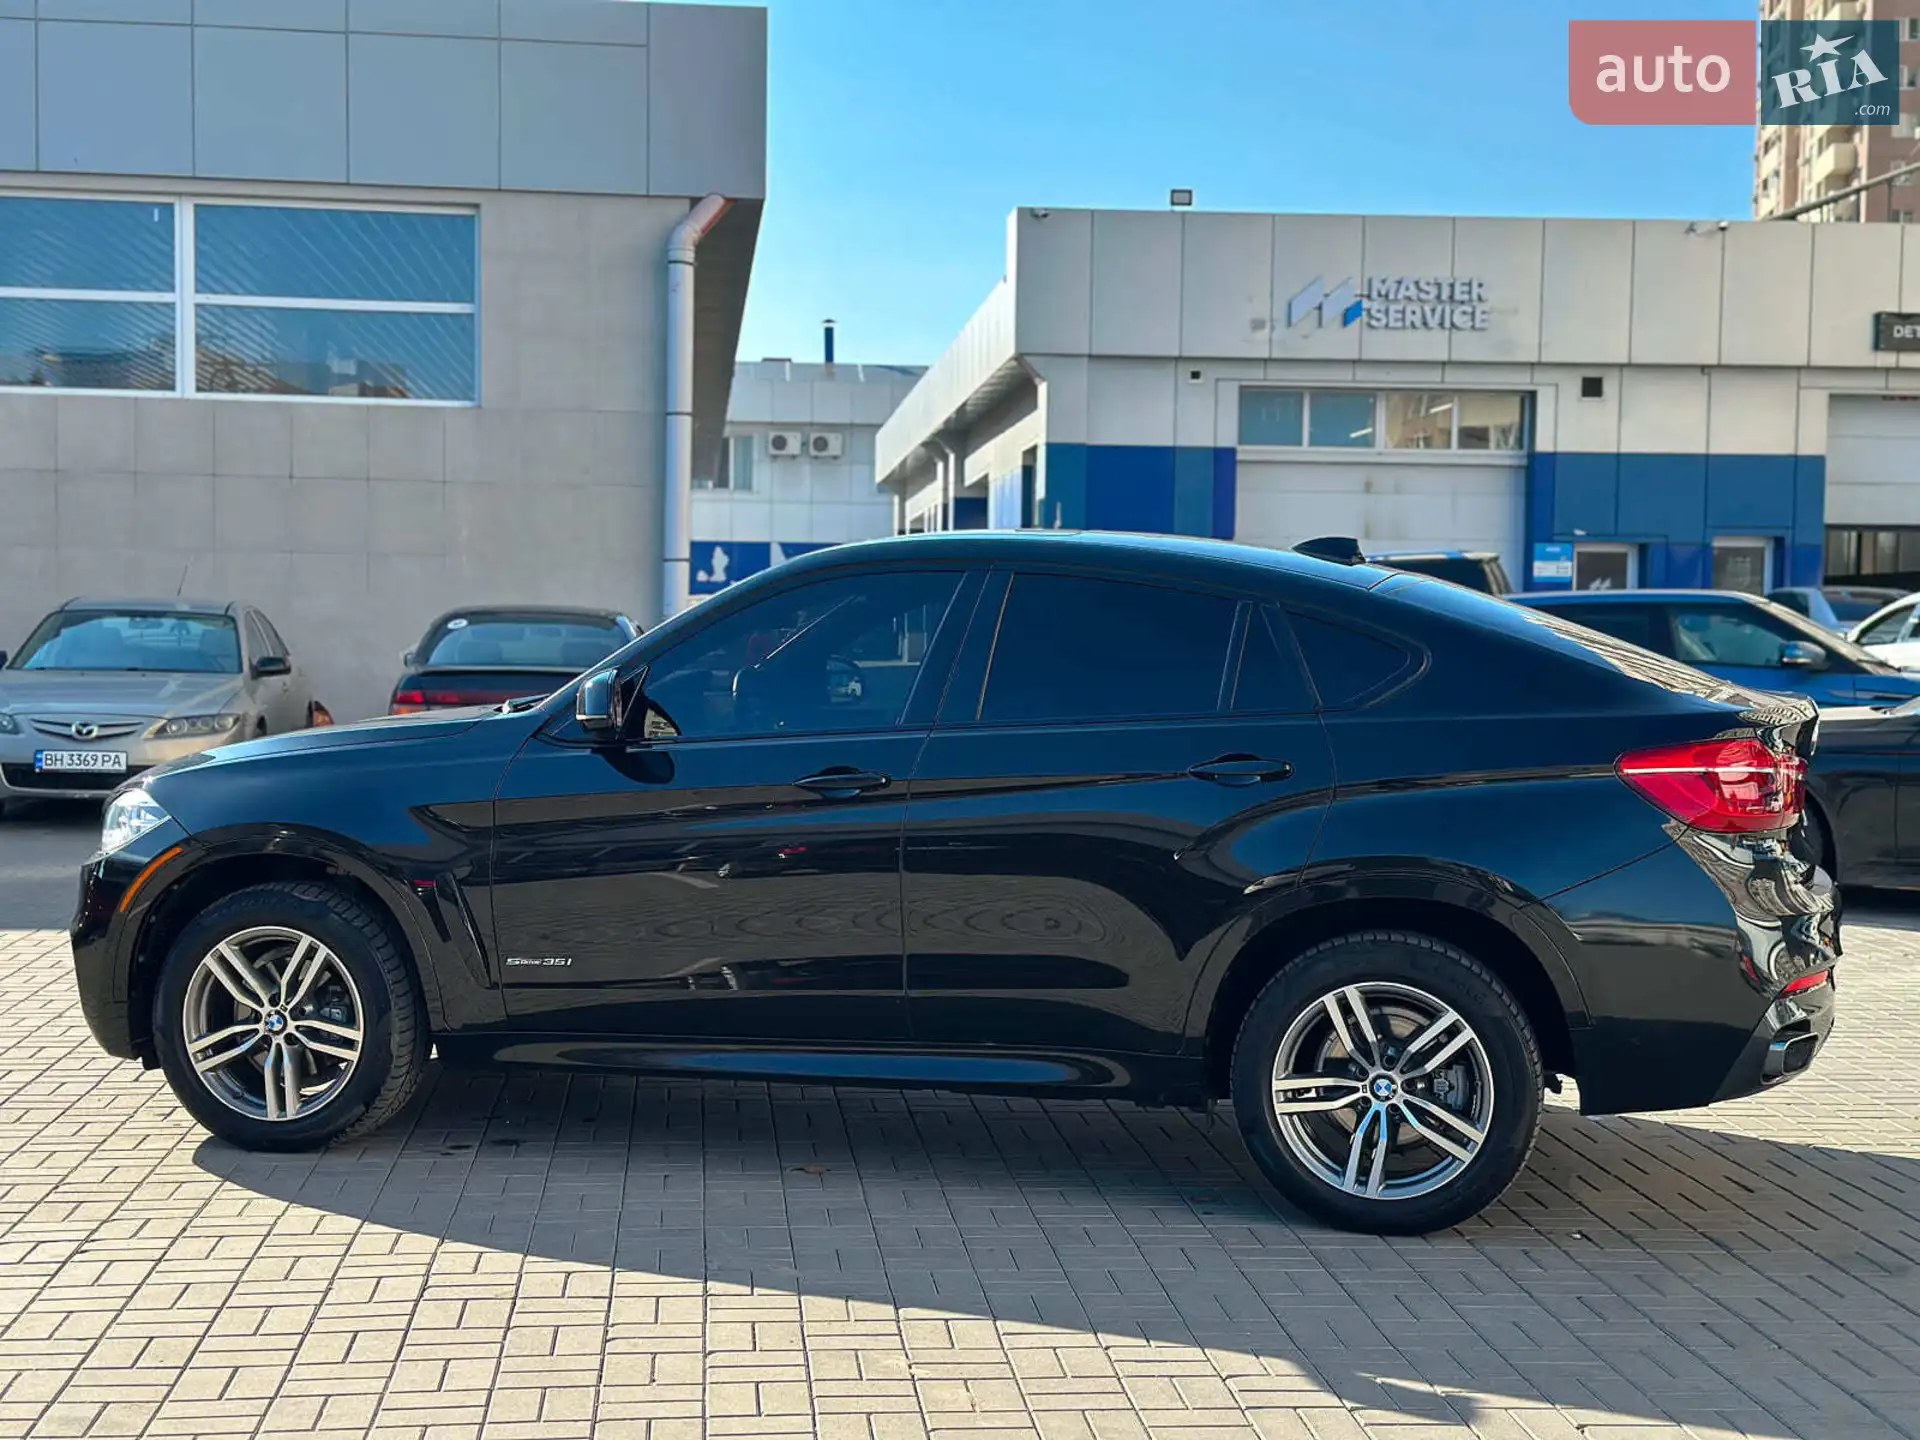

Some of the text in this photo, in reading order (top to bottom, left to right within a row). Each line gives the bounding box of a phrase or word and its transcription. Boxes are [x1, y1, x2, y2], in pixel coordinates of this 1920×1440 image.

[1368, 276, 1488, 302] MASTER
[1367, 304, 1490, 330] SERVICE
[44, 753, 122, 767] BH 3369 PA
